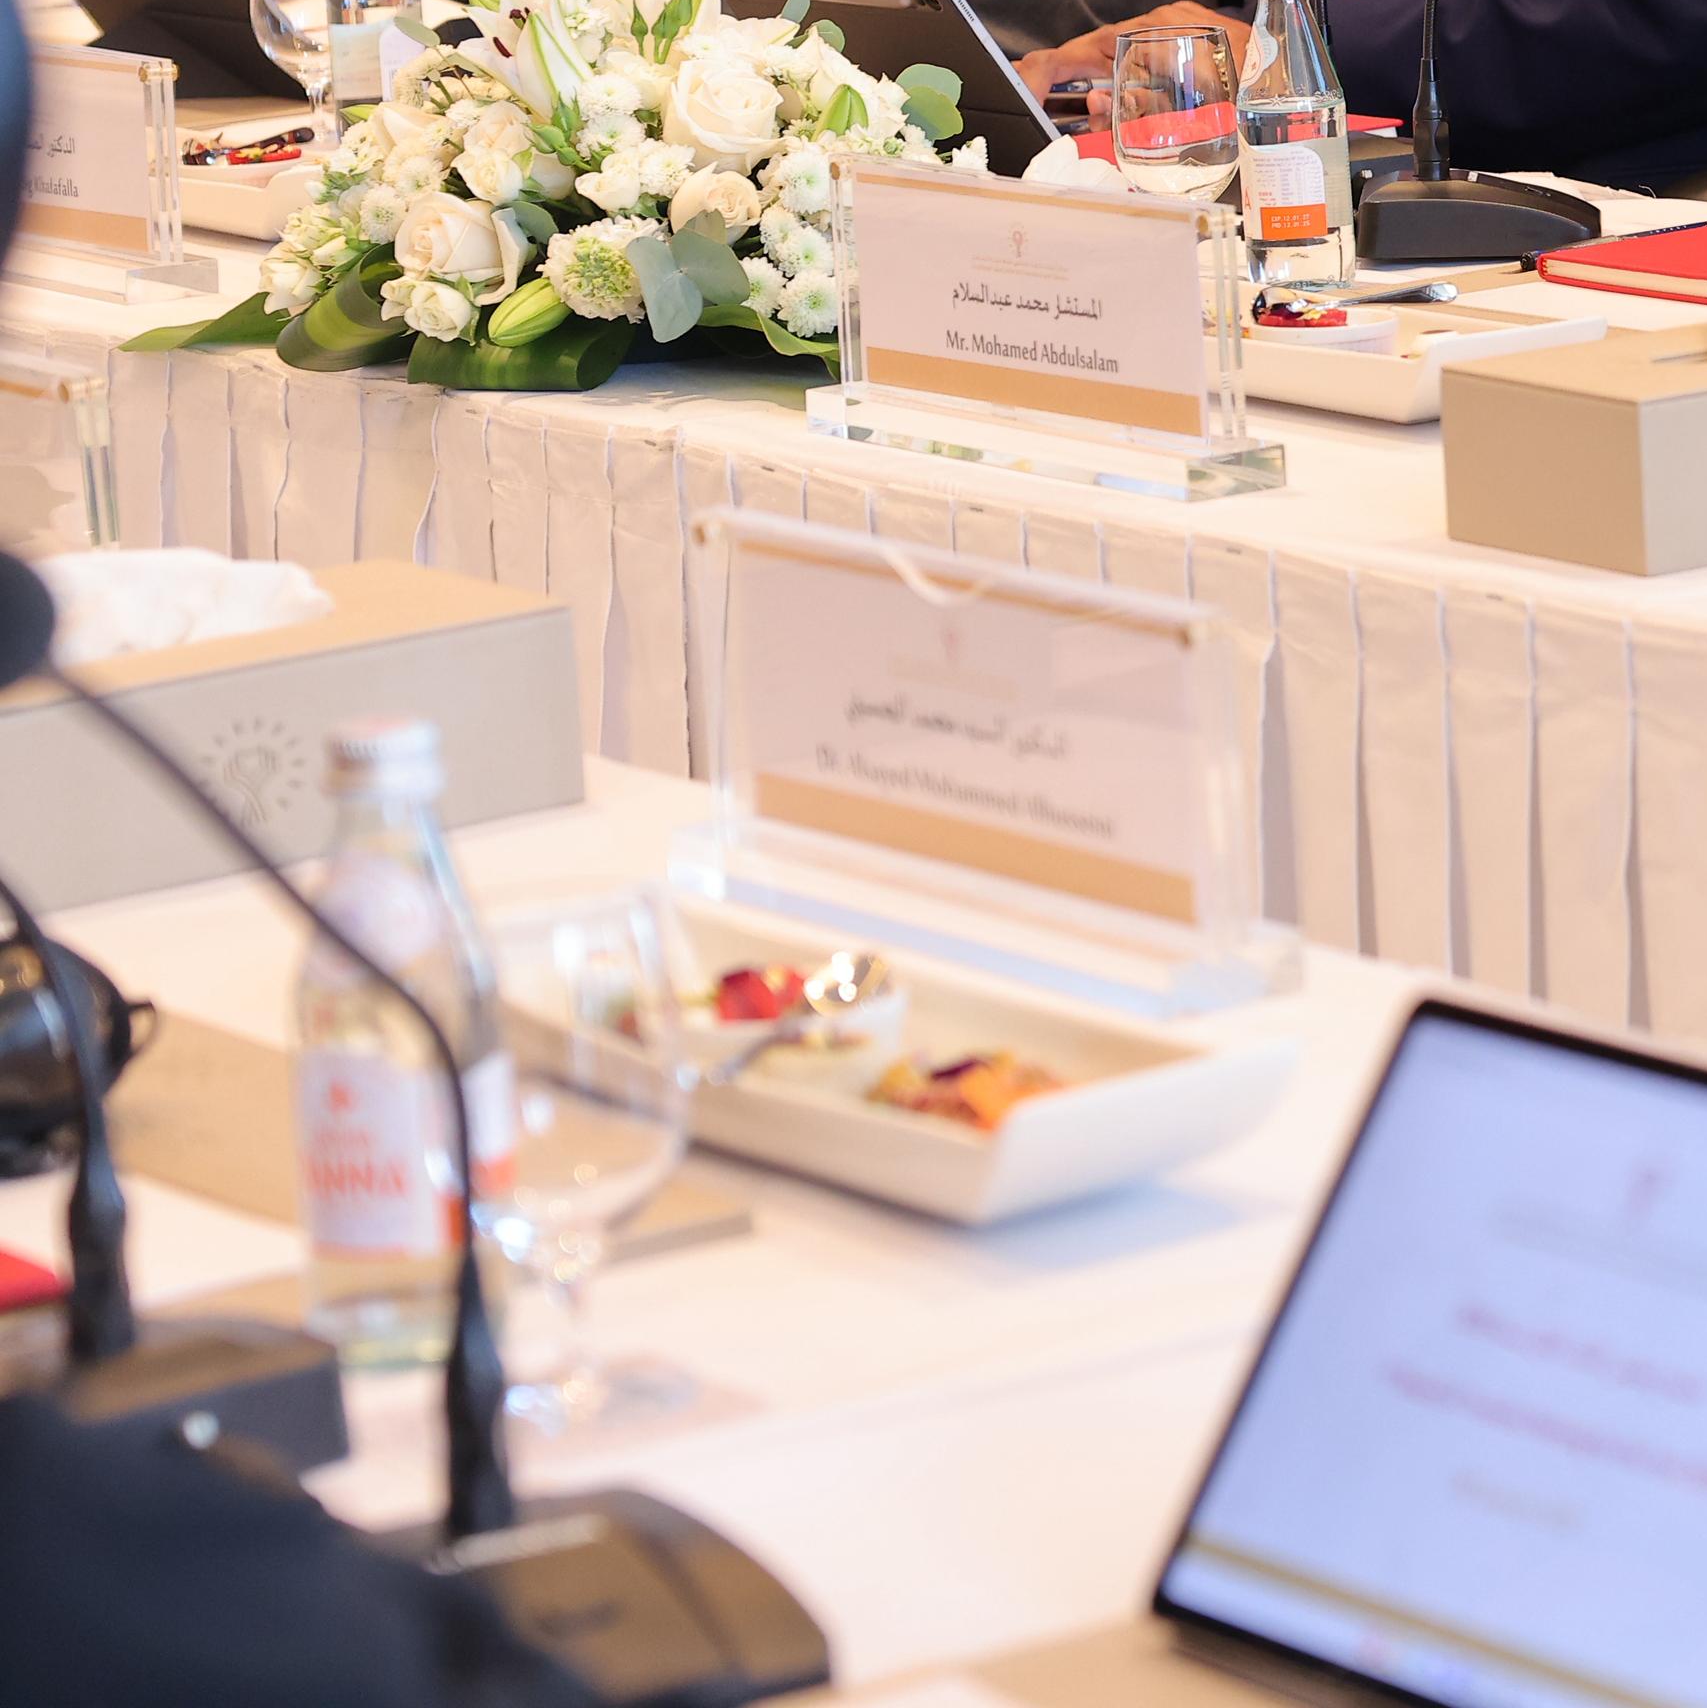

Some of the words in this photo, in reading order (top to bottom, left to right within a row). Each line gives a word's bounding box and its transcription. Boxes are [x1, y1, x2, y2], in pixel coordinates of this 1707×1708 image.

[1016, 295, 1050, 313] محمد
[1054, 294, 1103, 320] المستشار
[946, 330, 969, 352] Mr.
[972, 333, 1037, 362] Mohamed
[1041, 342, 1119, 373] Abdulsalam
